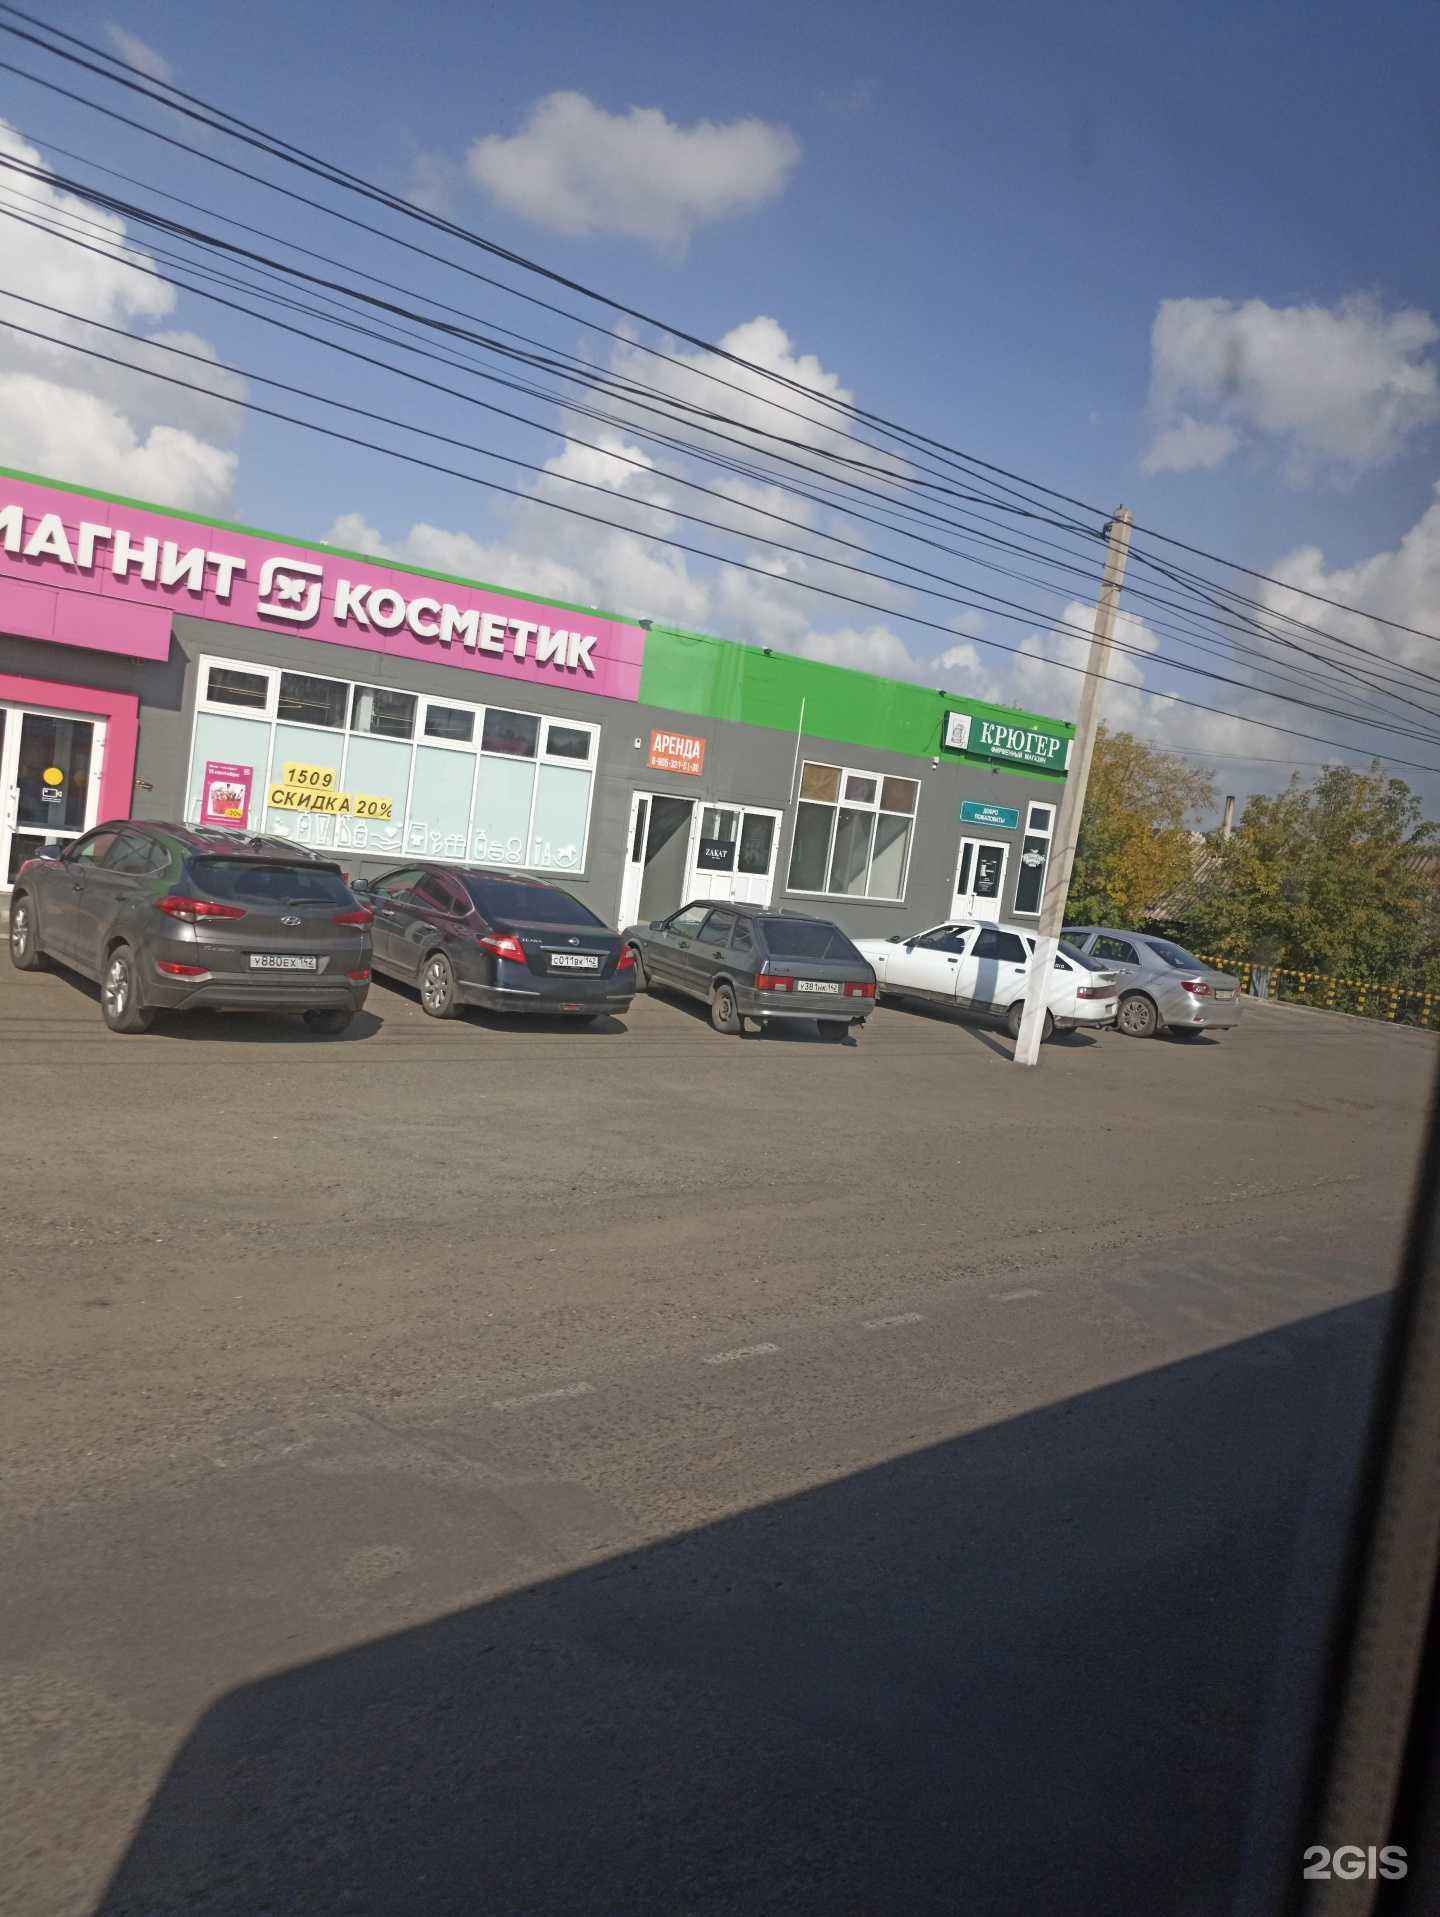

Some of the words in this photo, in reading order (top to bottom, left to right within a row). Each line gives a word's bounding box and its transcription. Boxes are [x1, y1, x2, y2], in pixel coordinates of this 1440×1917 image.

[334, 579, 598, 672] КОСМЕТИК
[653, 734, 700, 760] АРЕНДА
[980, 721, 1060, 758] КРЮГЕР
[271, 790, 350, 812] СКИДКА
[356, 800, 392, 818] 20%
[705, 848, 728, 858] ZAKAT
